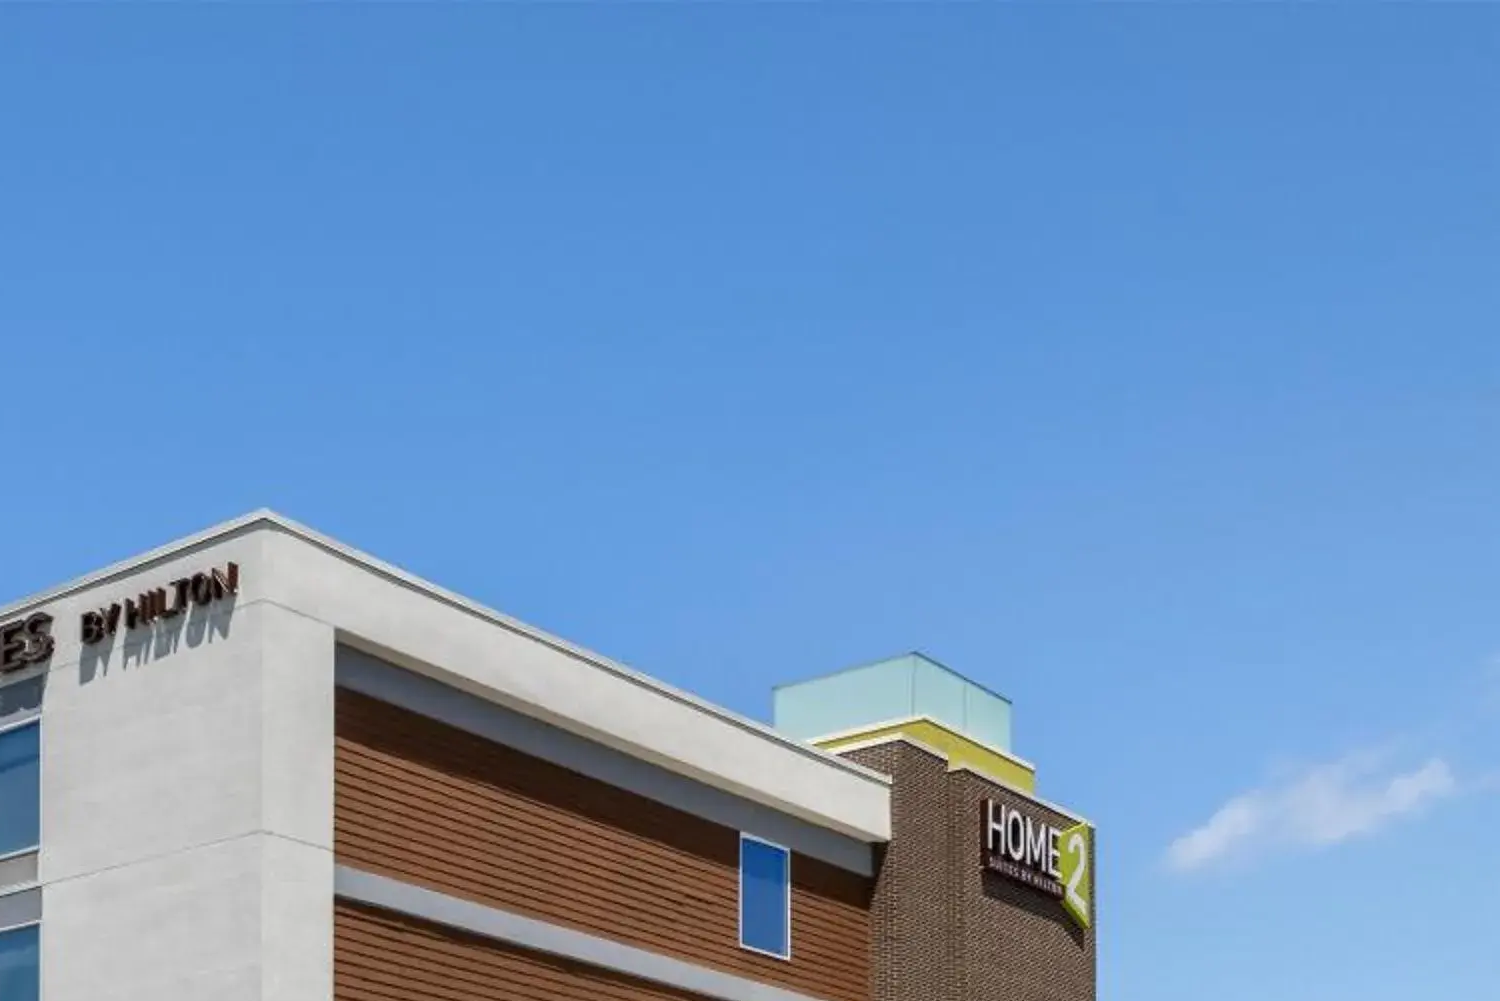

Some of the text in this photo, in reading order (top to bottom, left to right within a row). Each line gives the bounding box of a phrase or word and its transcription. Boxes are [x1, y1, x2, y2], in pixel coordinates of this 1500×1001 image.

[81, 603, 121, 645] BY
[125, 561, 239, 630] HILTON
[987, 799, 1088, 919] HOME 2
